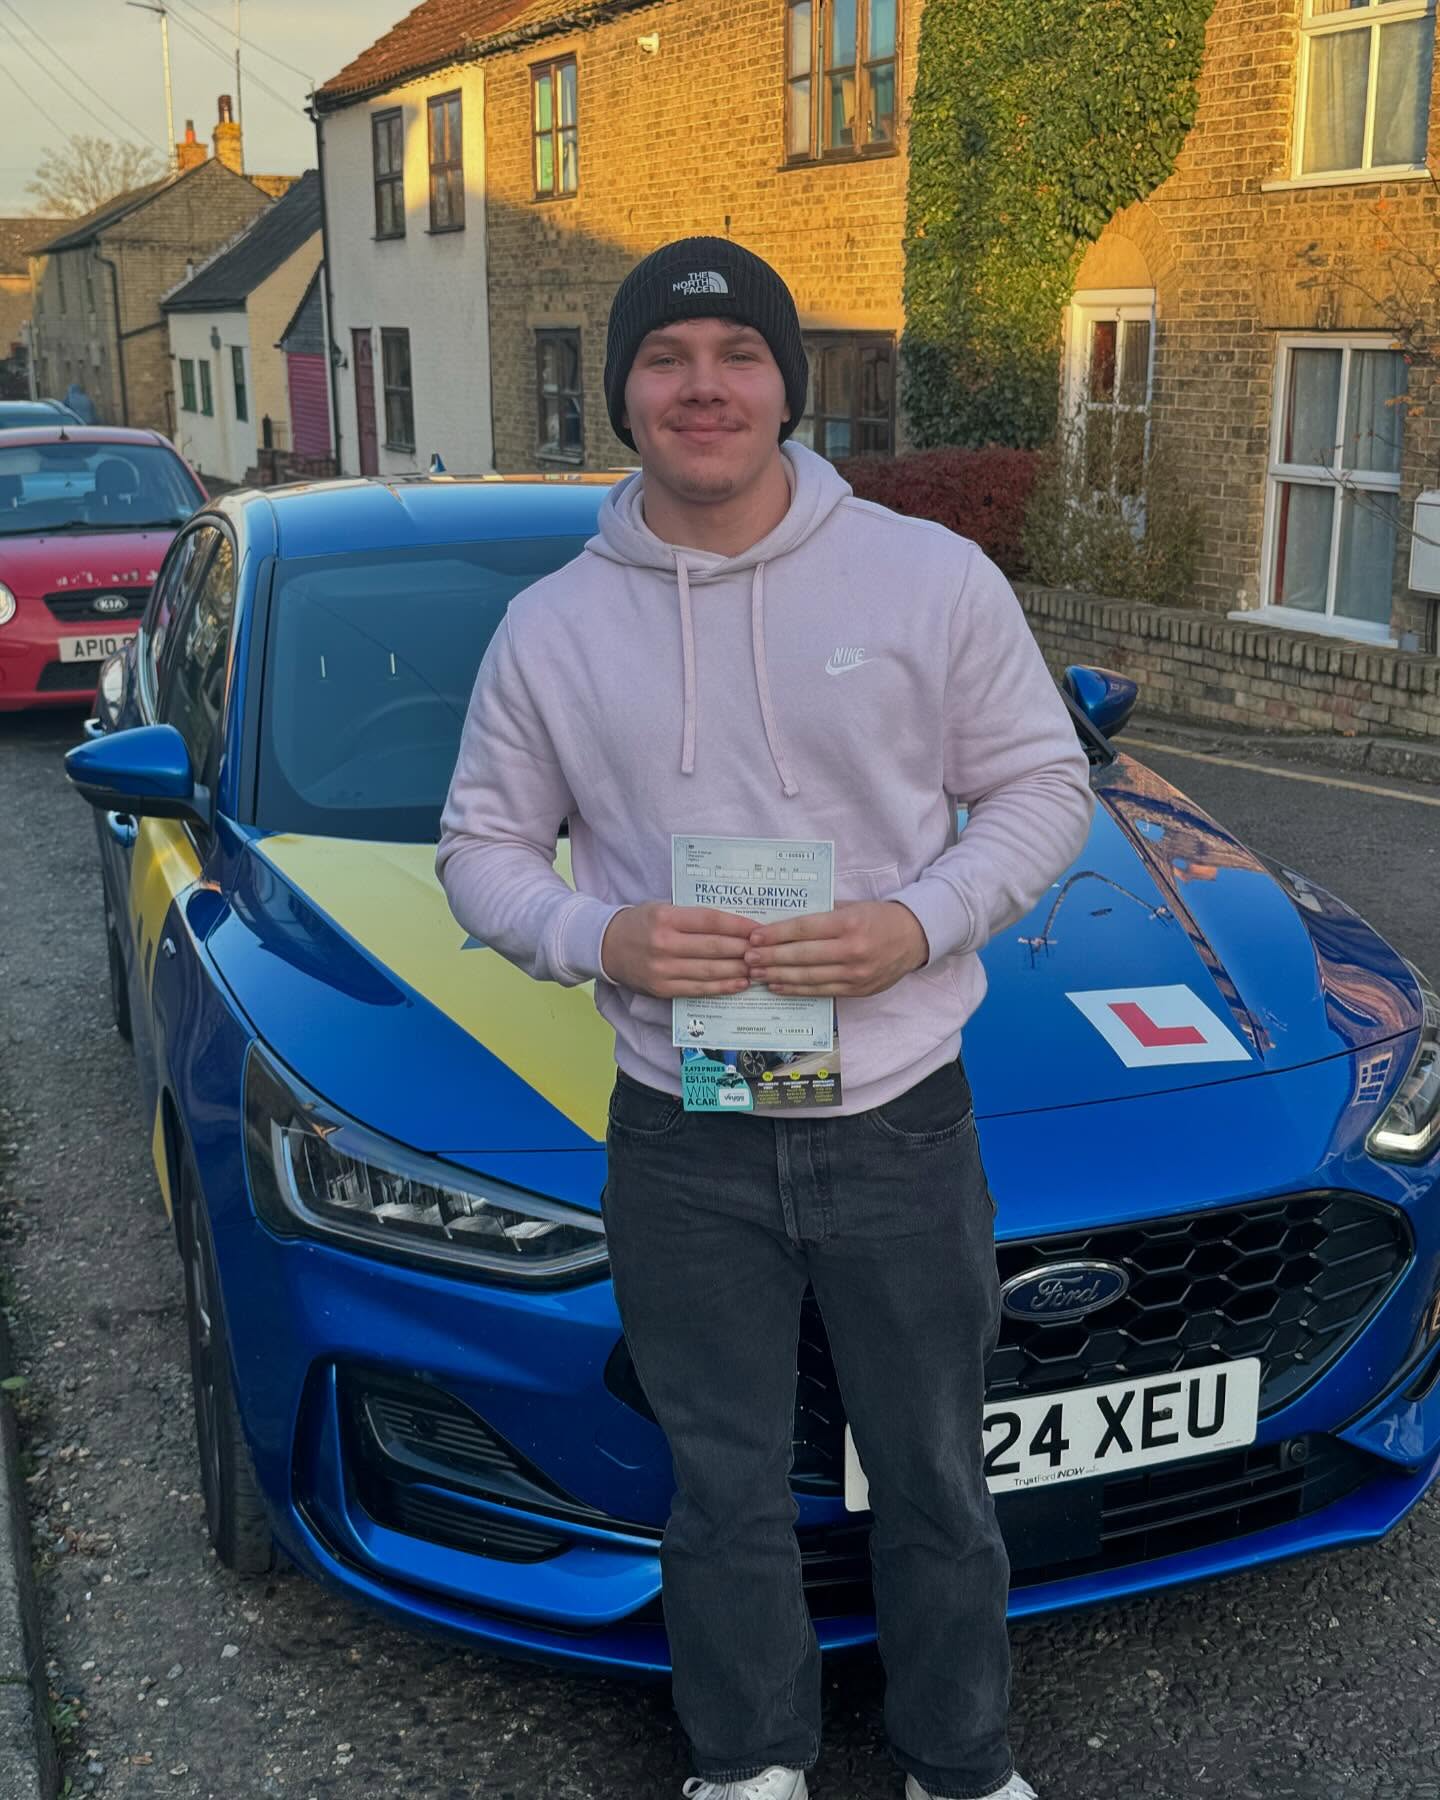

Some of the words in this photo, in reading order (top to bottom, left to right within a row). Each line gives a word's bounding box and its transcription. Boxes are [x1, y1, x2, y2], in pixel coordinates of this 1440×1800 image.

[688, 271, 708, 280] THE
[672, 278, 709, 292] NORTH
[683, 285, 709, 296] FACE
[833, 647, 865, 664] NIKE
[695, 883, 755, 896] PRACTICAL
[757, 886, 808, 898] DRIVING
[695, 894, 718, 904] TEST
[720, 896, 743, 906] PASS
[746, 897, 808, 908] CERTIFICATE
[1107, 1002, 1208, 1048] L
[686, 1085, 716, 1098] WIN
[687, 1098, 694, 1106] A
[1030, 1275, 1101, 1310] Ford
[1094, 1372, 1227, 1459] XEU
